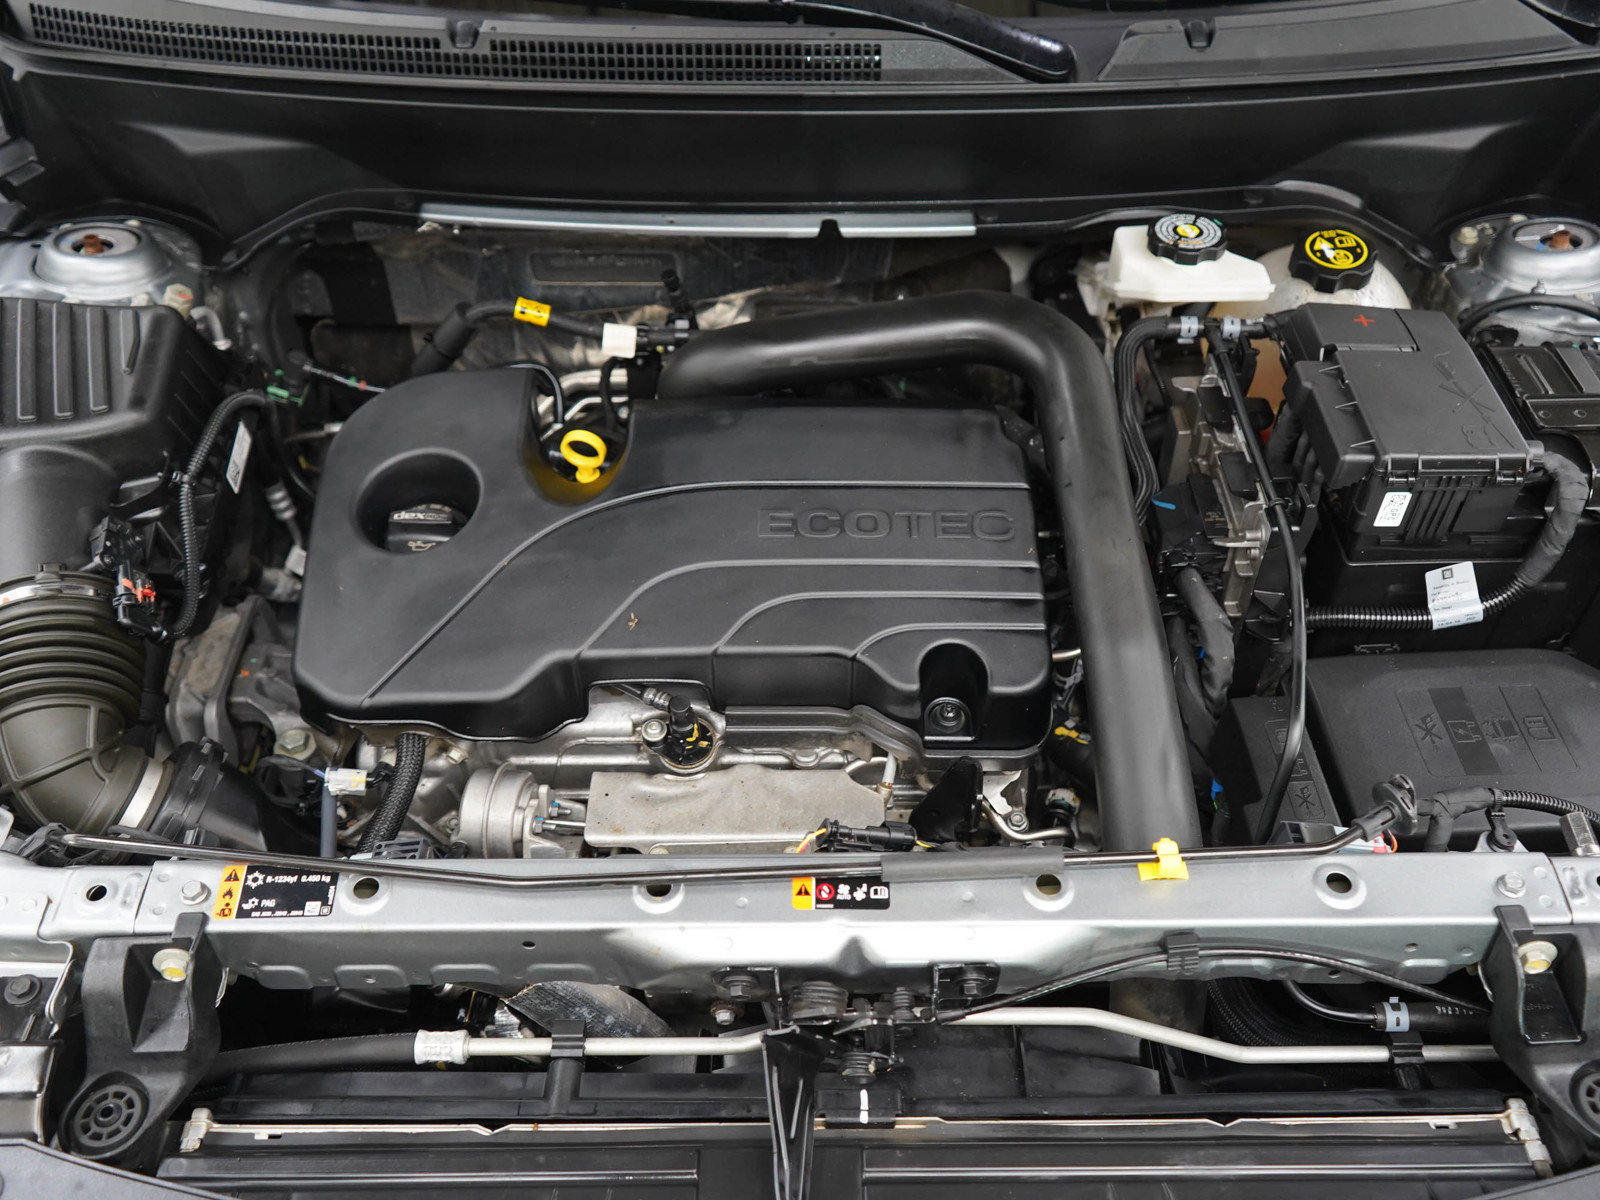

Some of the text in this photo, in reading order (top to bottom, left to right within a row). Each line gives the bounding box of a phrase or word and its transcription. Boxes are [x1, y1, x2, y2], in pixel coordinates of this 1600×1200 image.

[758, 509, 1015, 540] ECOTEC
[321, 875, 331, 883] kg
[261, 899, 276, 907] PAG
